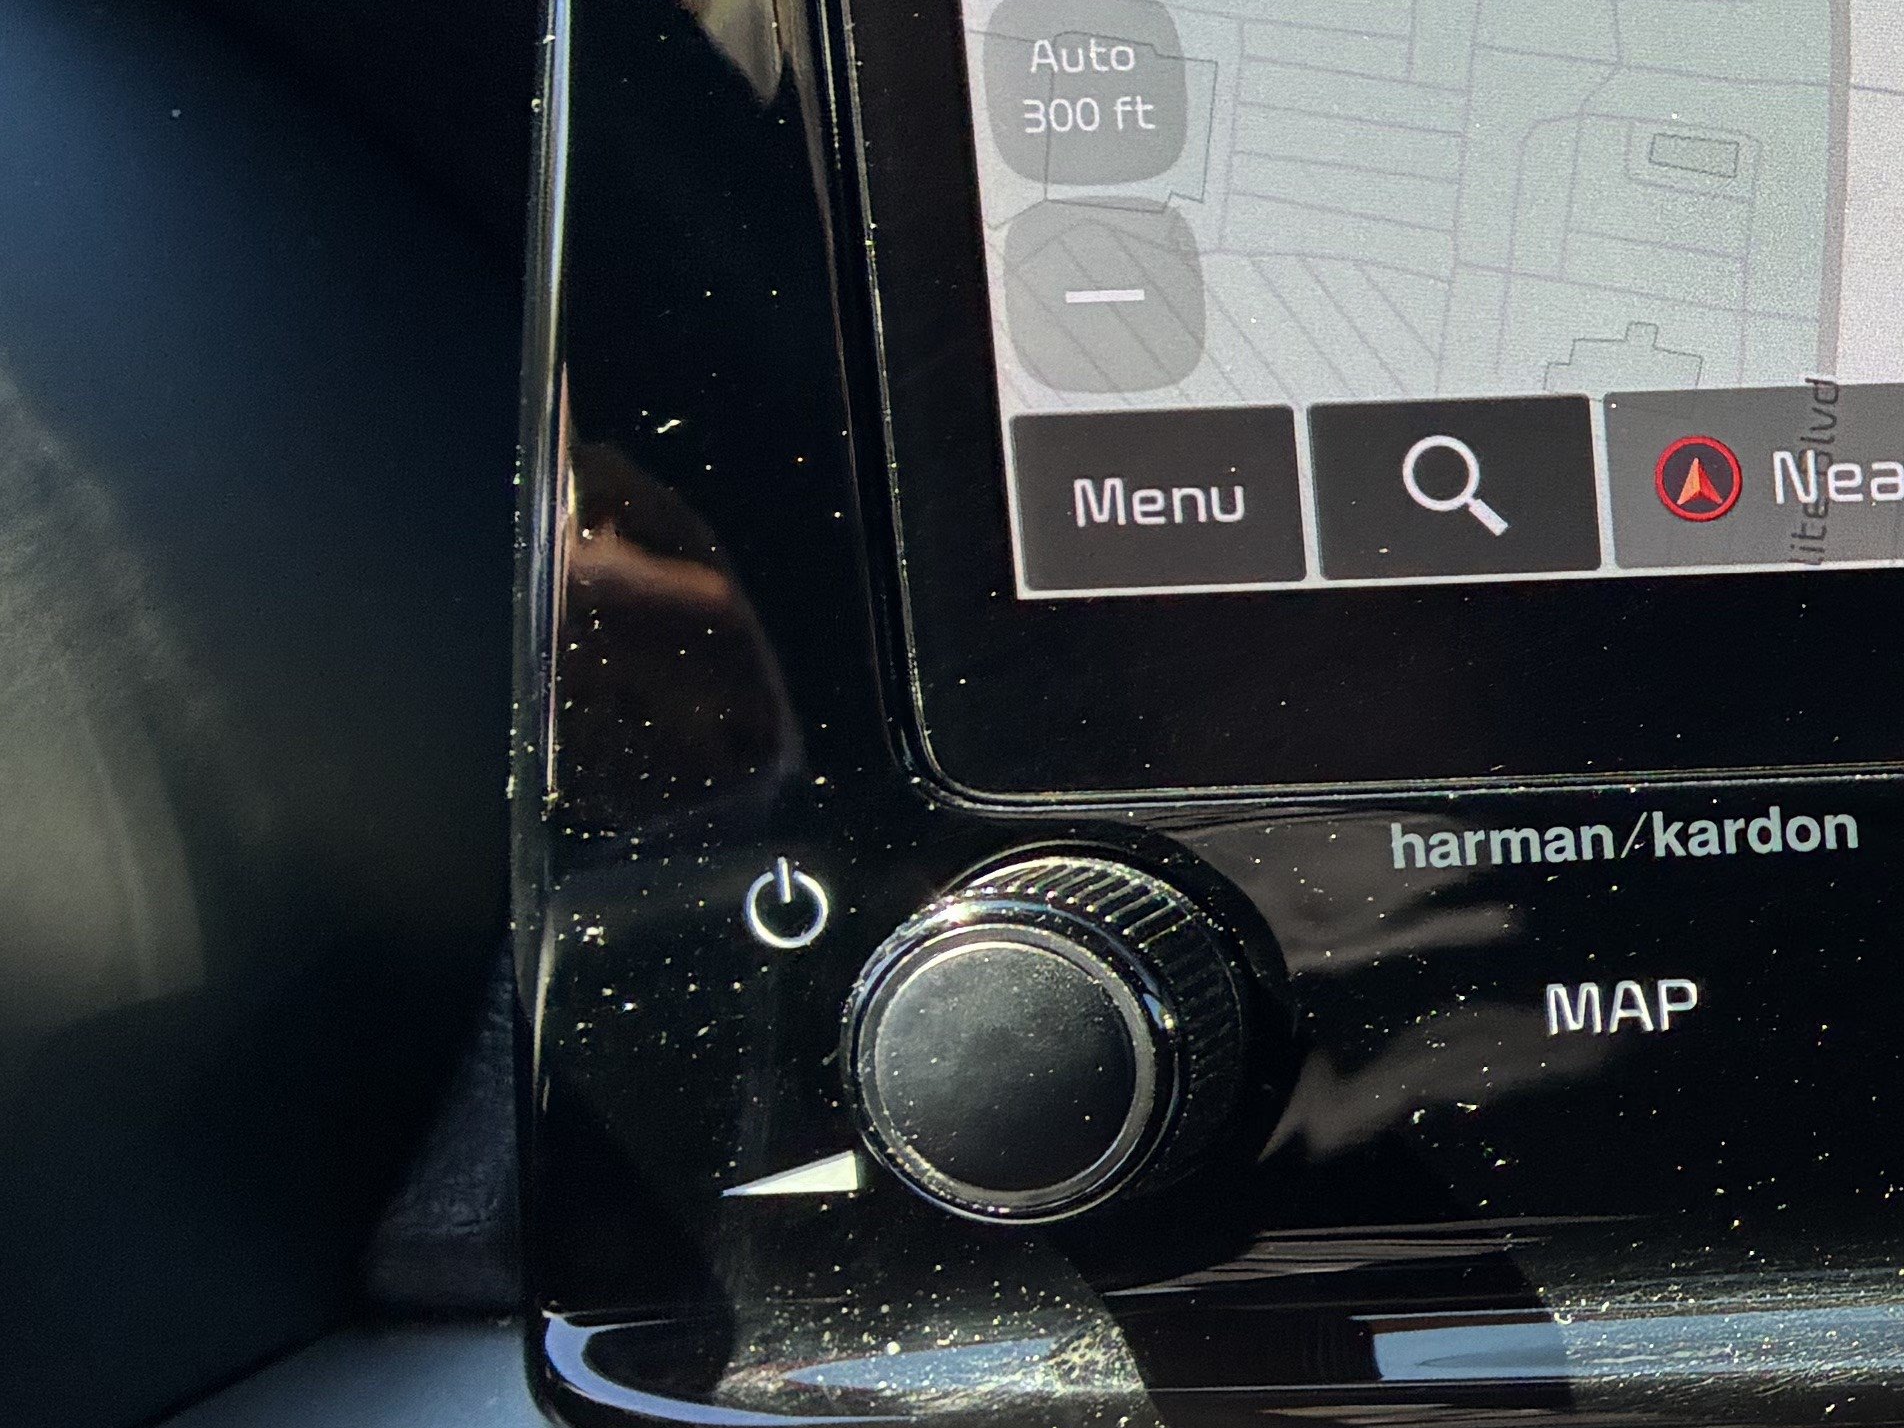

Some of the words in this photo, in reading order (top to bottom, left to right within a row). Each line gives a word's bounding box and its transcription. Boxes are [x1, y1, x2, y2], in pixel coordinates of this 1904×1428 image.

[1028, 36, 1137, 75] Auto
[1021, 96, 1101, 135] 300
[1112, 94, 1157, 132] ft
[1072, 476, 1246, 529] Menu
[1390, 805, 1860, 871] harman/kardon
[1545, 977, 1699, 1037] MAP
